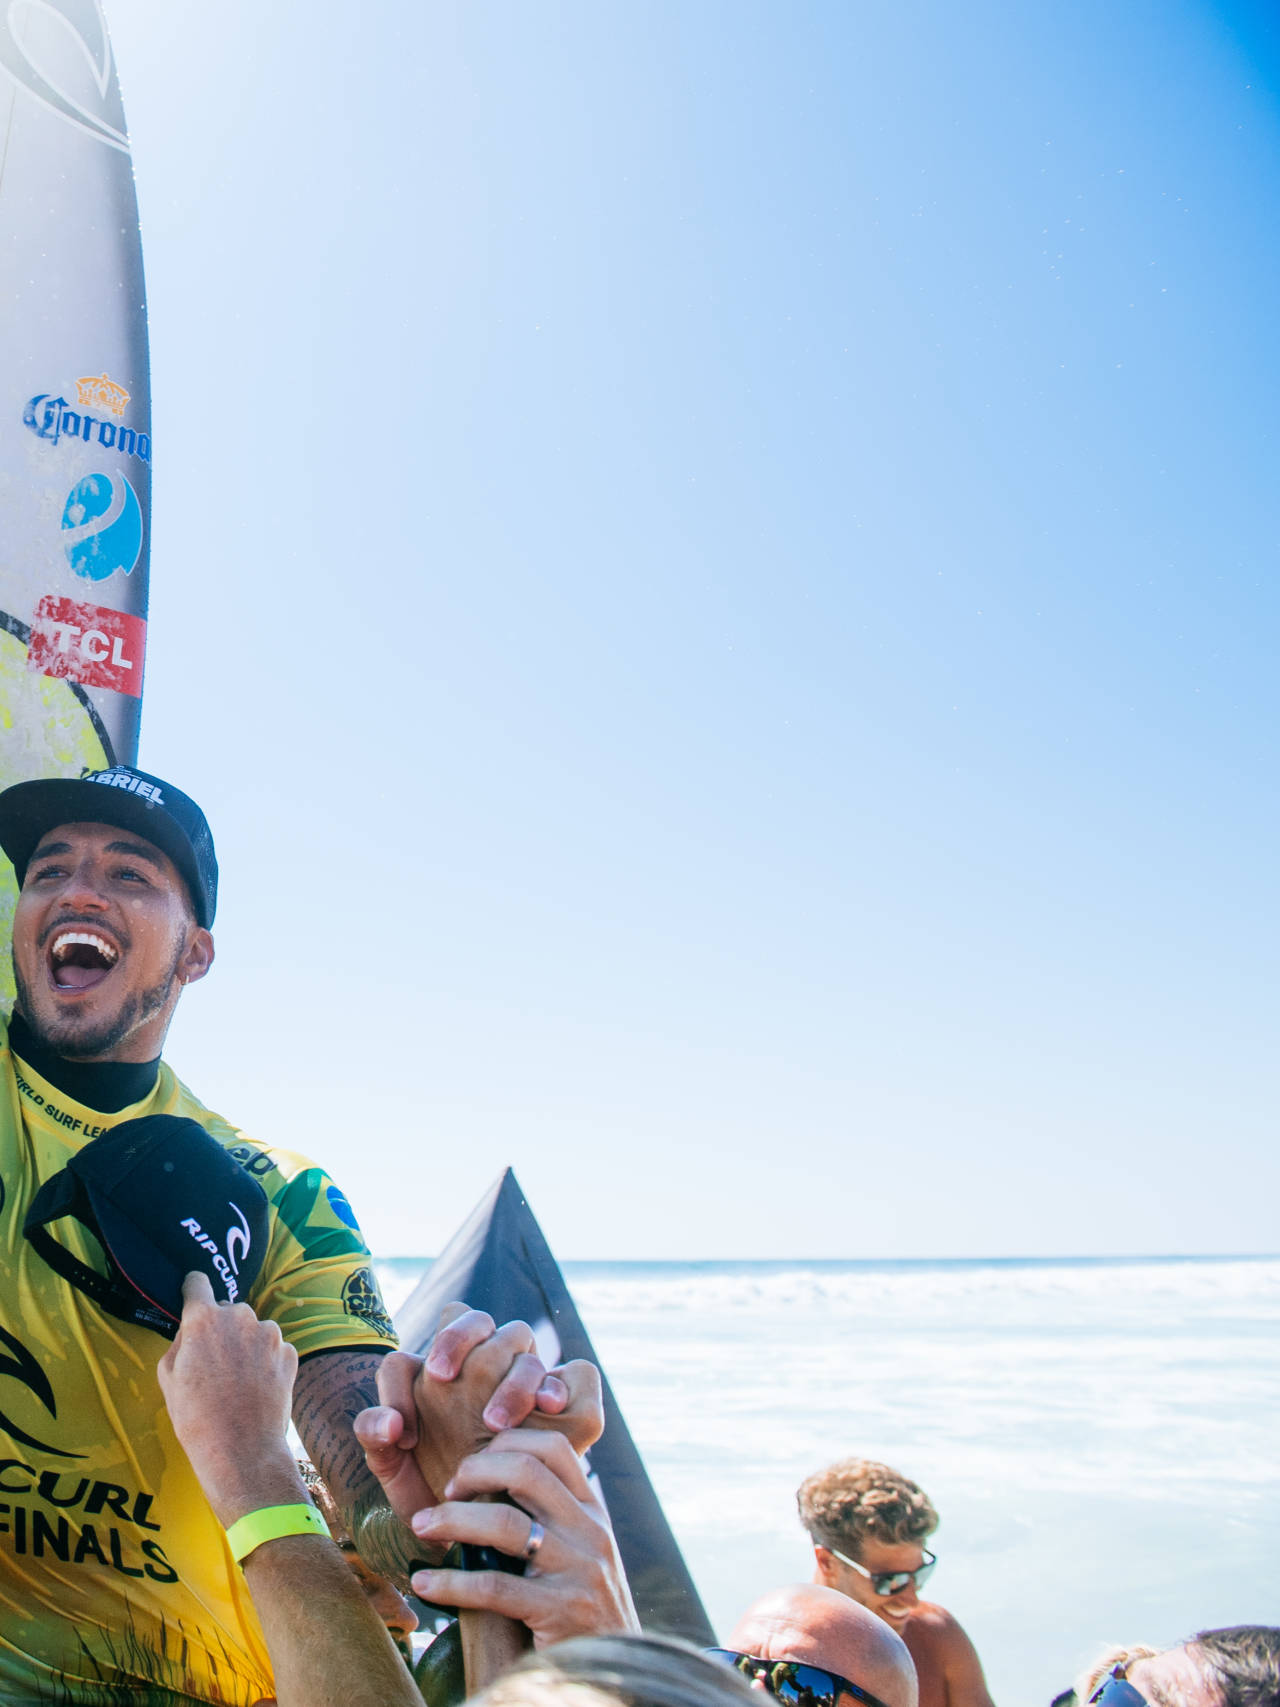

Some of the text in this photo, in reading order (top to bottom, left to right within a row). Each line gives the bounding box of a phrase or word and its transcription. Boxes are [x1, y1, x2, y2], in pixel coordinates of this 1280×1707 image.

[23, 394, 151, 463] Corona
[49, 621, 133, 670] TCL
[44, 1103, 83, 1132] SURF
[180, 1217, 239, 1304] RIP CURL
